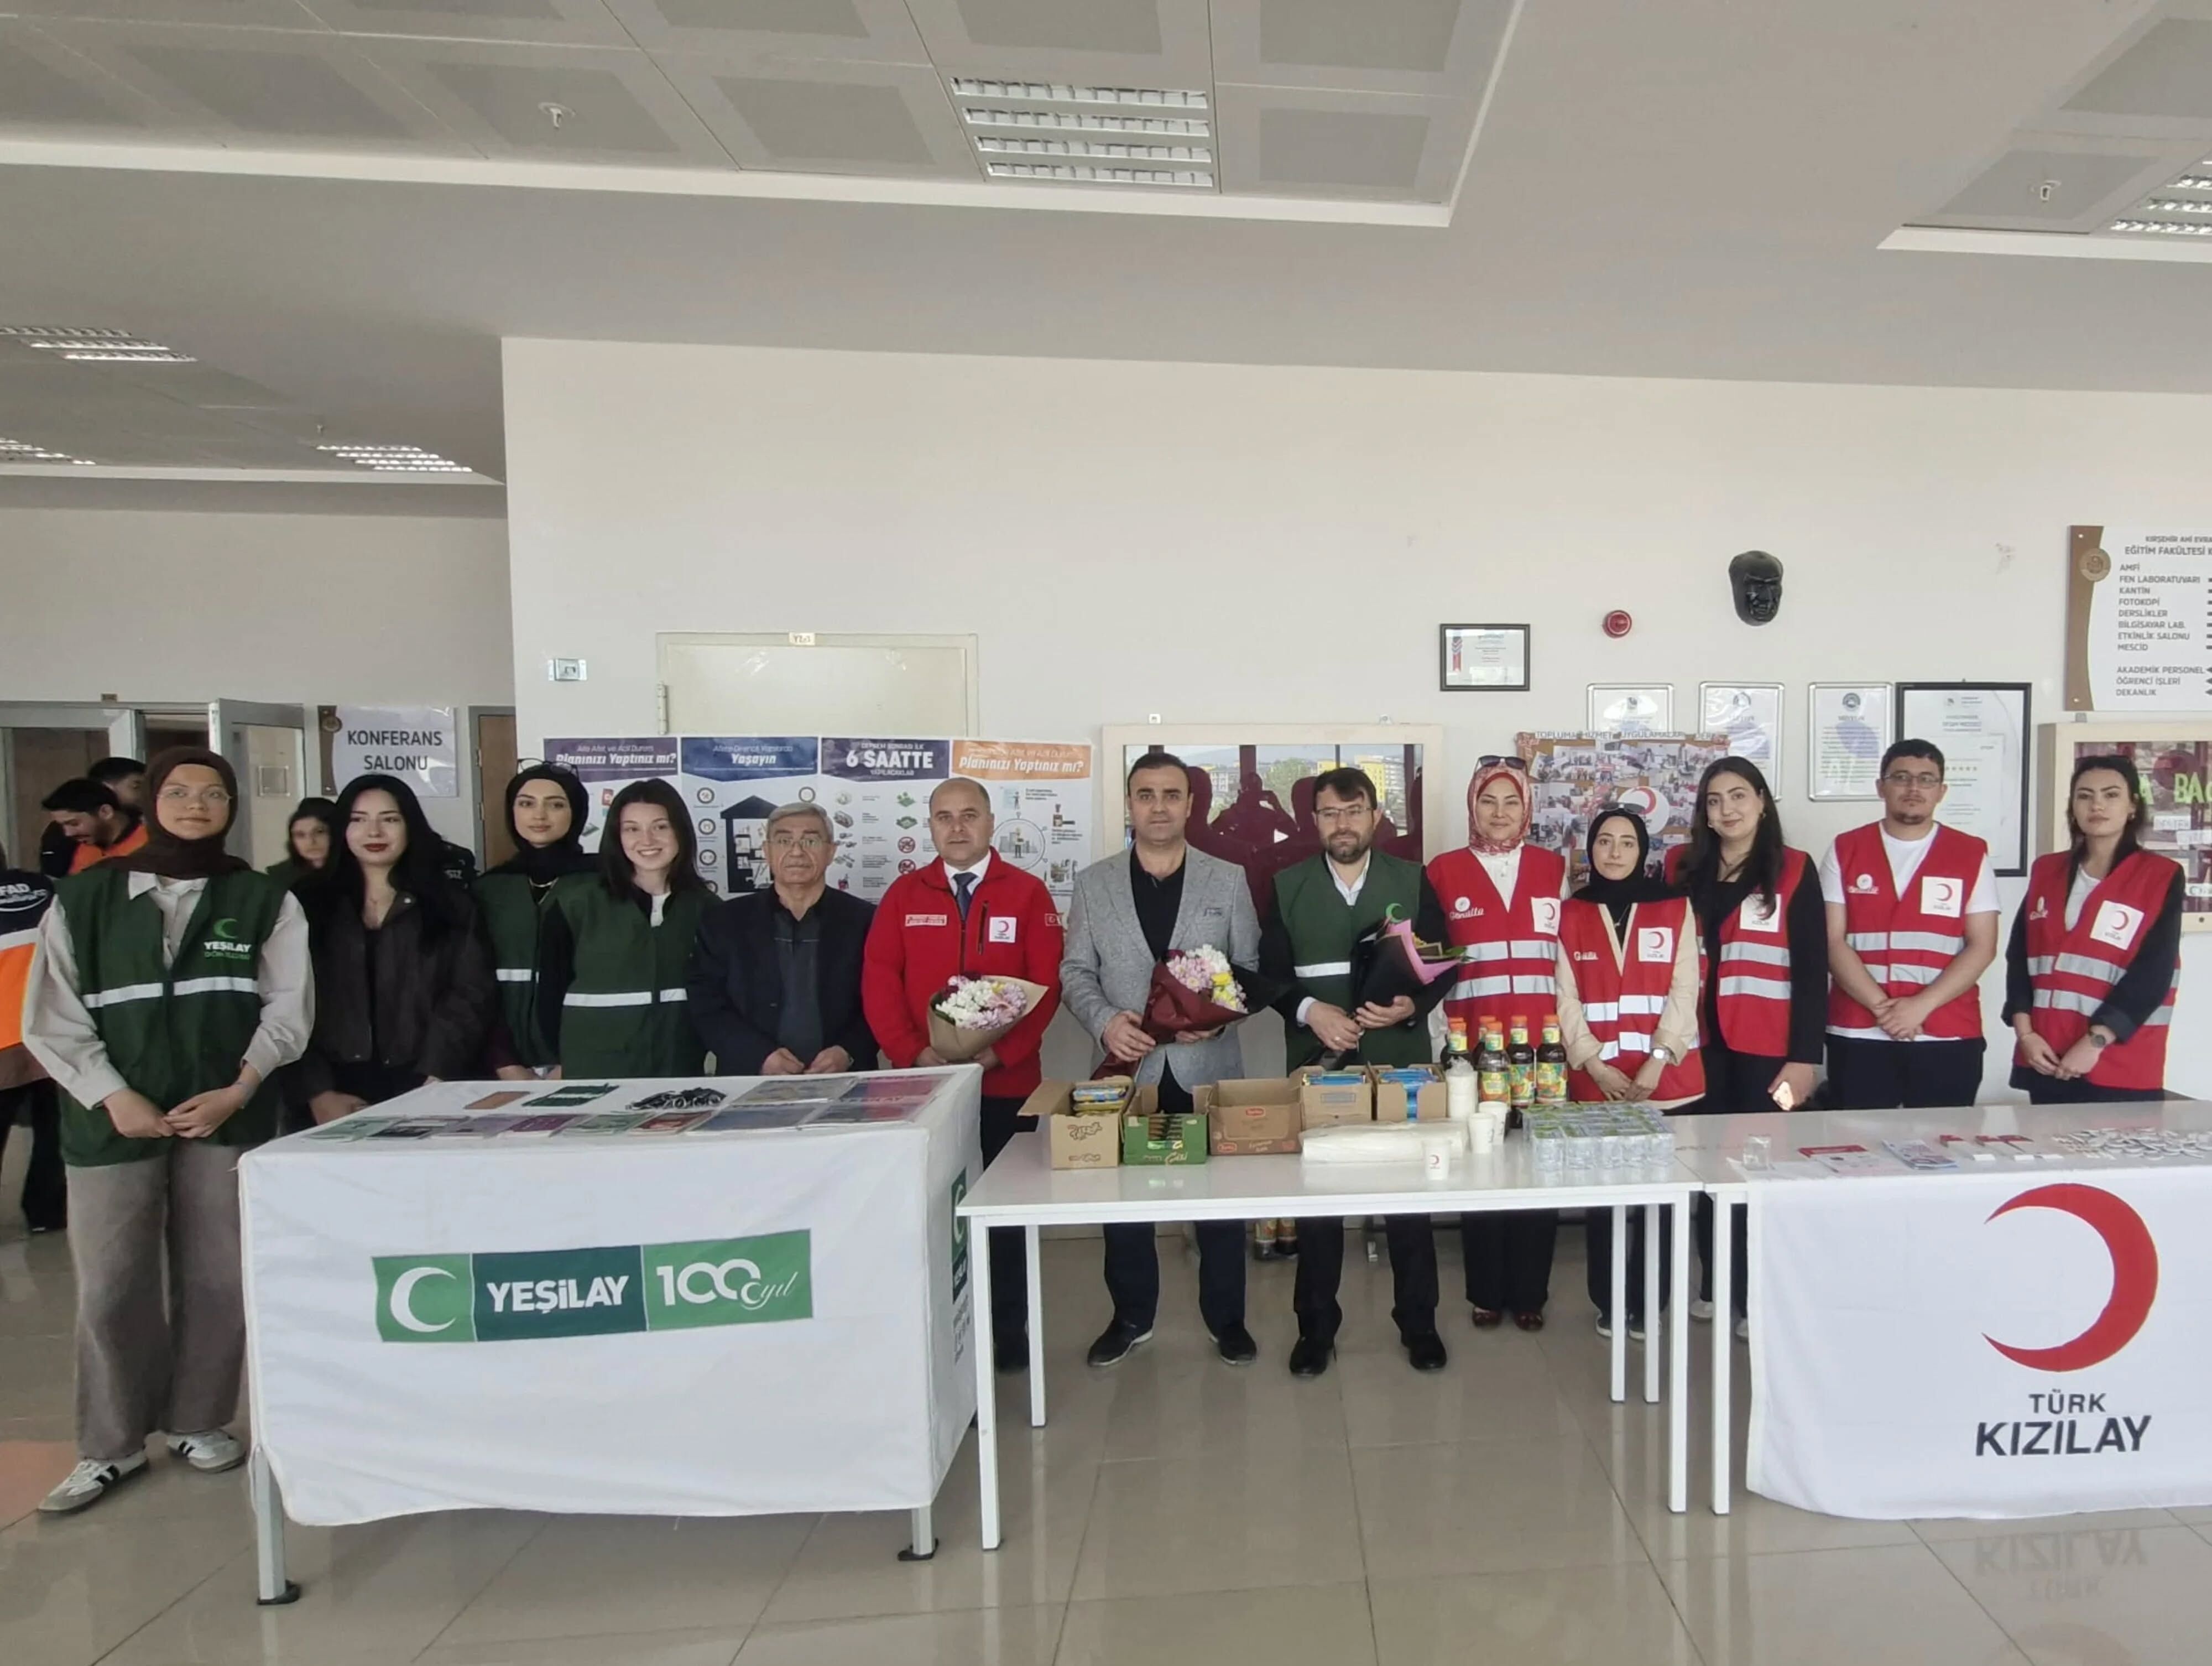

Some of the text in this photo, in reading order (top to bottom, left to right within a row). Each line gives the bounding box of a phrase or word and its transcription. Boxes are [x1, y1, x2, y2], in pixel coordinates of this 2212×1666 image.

[2125, 545, 2156, 555] EĞİTİM
[2158, 545, 2205, 555] FAKÜLTESİ
[2120, 563, 2140, 571] AMFİ
[2116, 676, 2153, 685] ÖĞRENCİ
[347, 730, 443, 746] KONFERANS
[363, 754, 428, 770] SALONU
[610, 753, 654, 766] Yaptınız
[731, 753, 776, 766] Yaşayın
[846, 749, 933, 769] 6 SAATTE
[1013, 757, 1059, 773] Yaptınız
[487, 1275, 629, 1314] YEŞİLAY
[2028, 1388, 2106, 1414] TÜRK
[1975, 1415, 2152, 1456] KIZILAY
